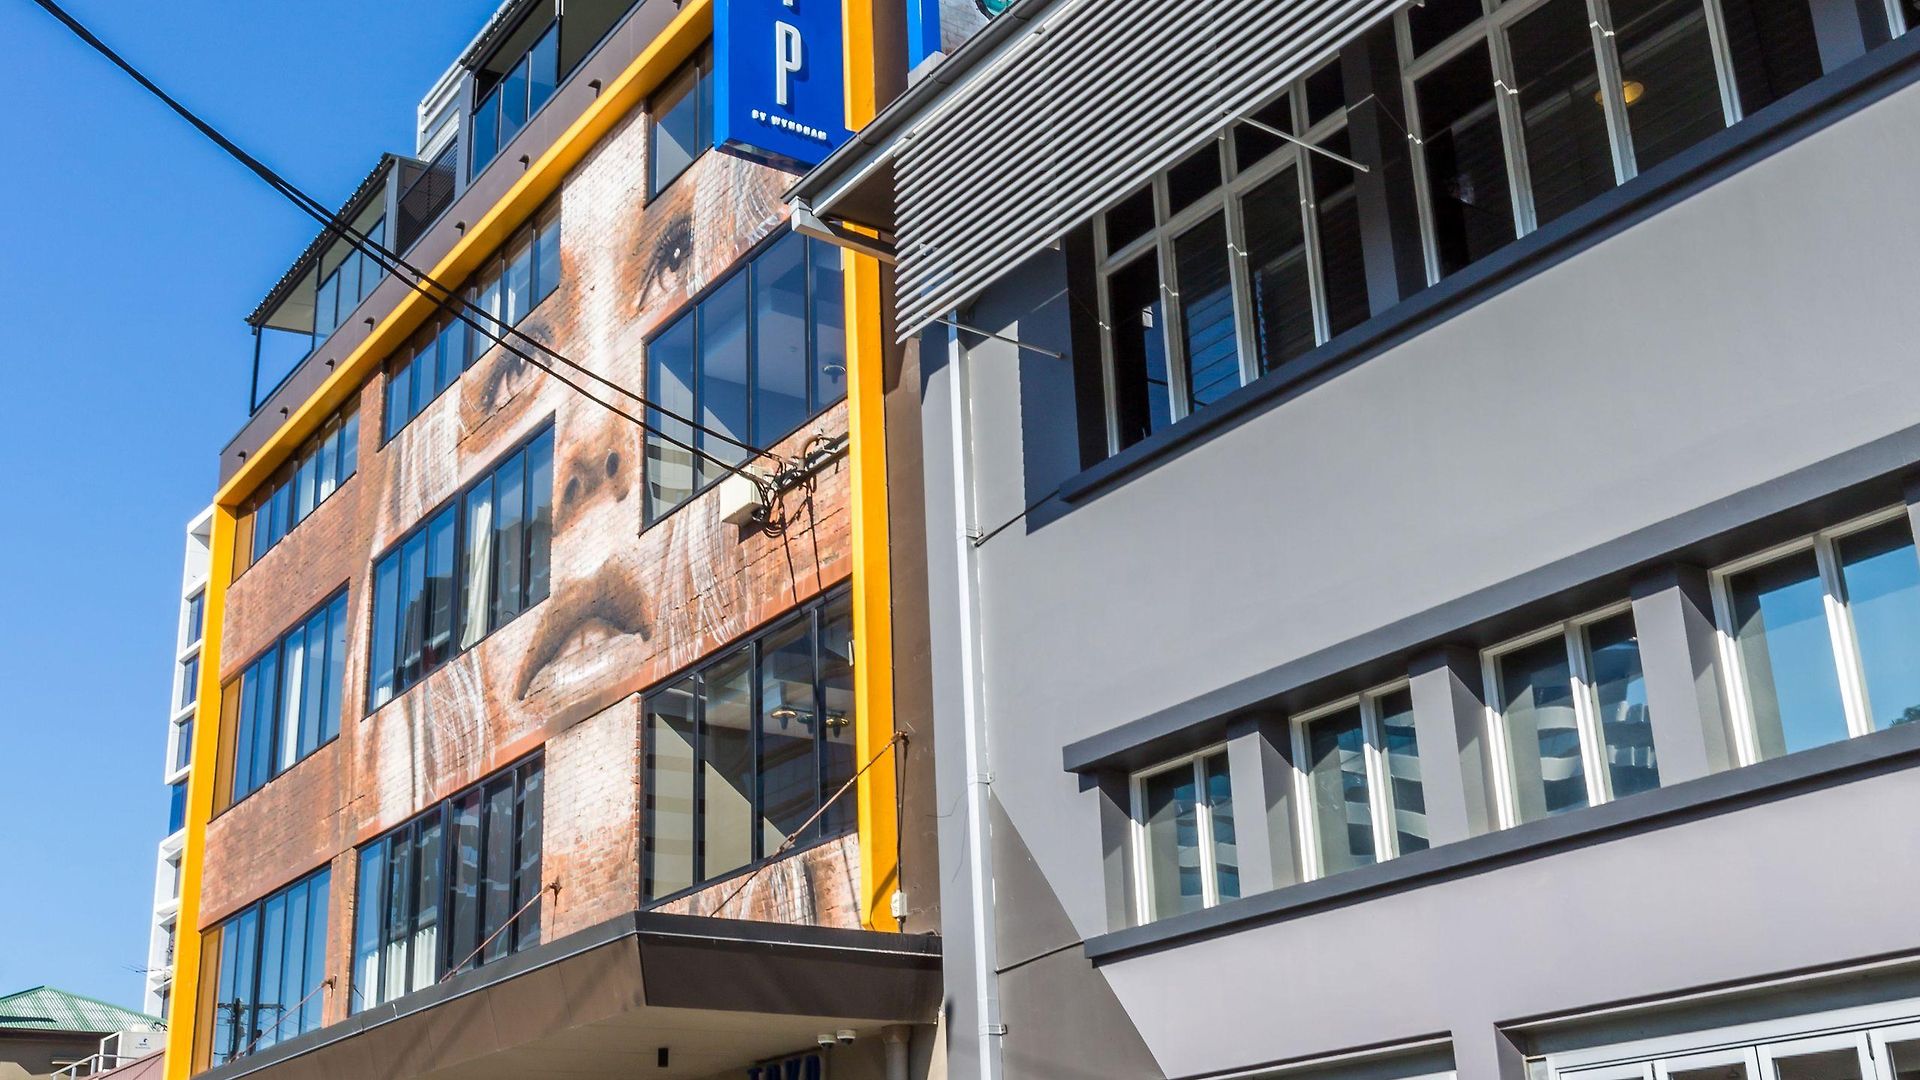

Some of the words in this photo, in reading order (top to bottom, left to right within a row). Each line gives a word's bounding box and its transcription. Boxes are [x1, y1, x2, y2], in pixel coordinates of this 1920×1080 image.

[776, 0, 802, 105] P
[752, 109, 767, 121] BY
[771, 115, 827, 140] WYNDHAM
